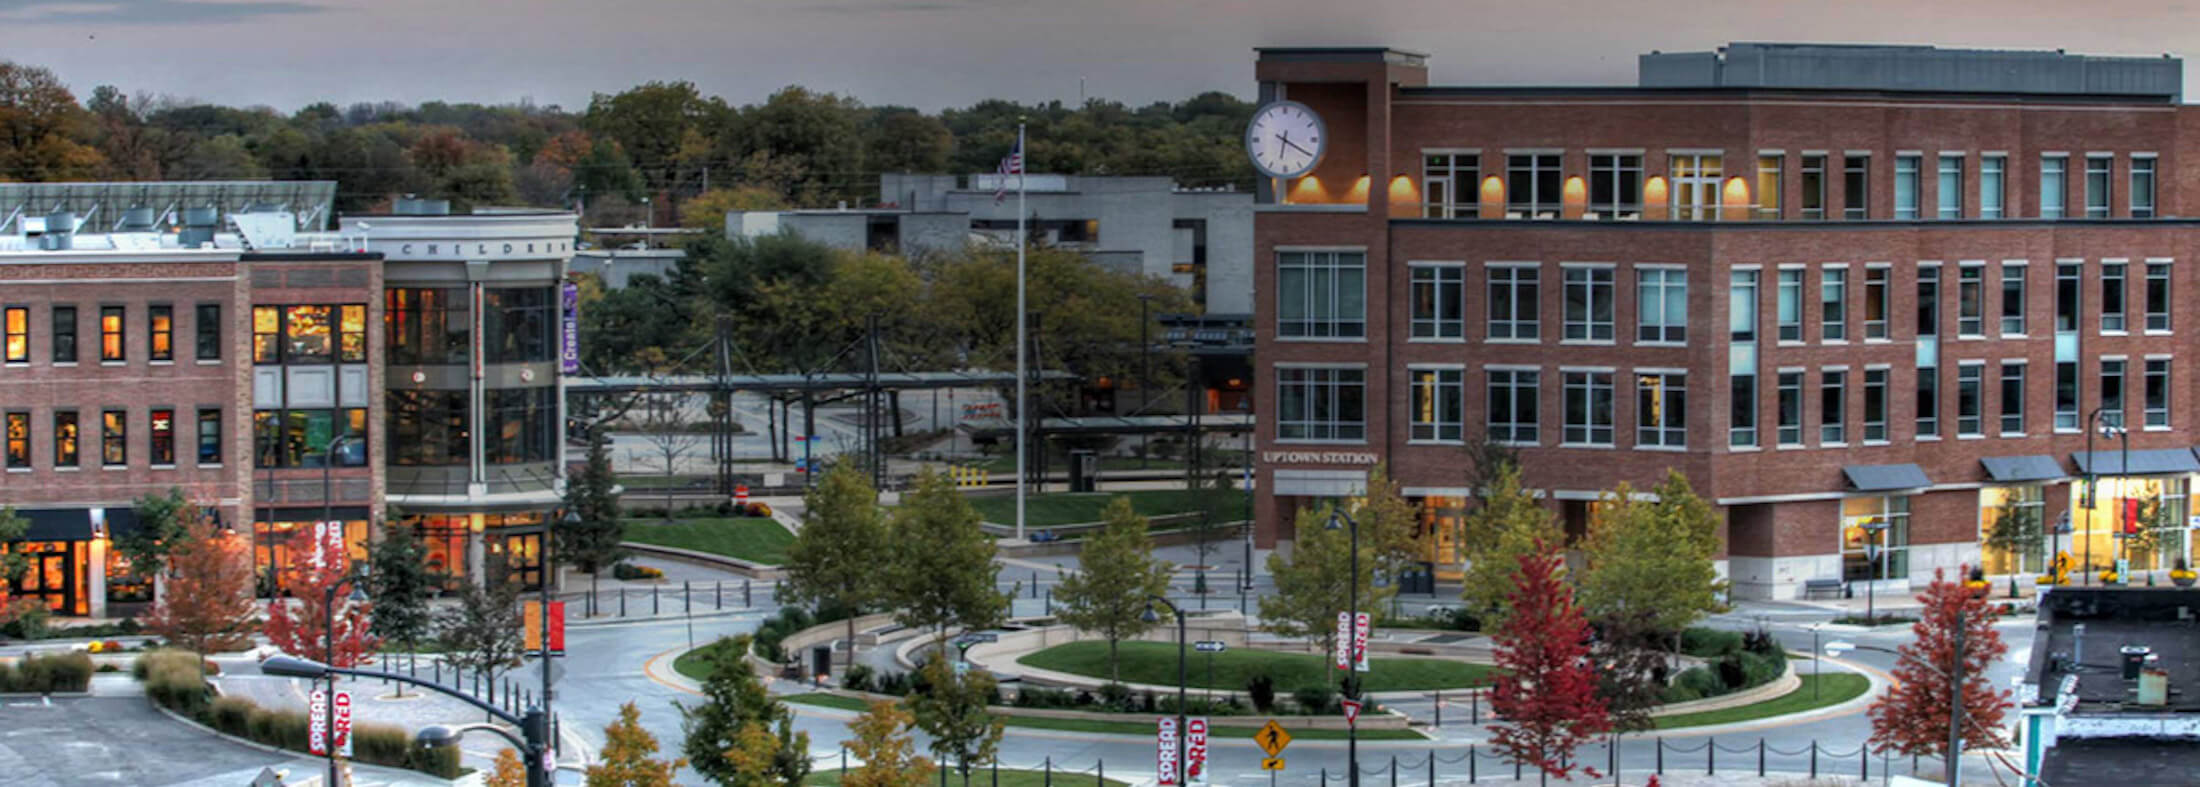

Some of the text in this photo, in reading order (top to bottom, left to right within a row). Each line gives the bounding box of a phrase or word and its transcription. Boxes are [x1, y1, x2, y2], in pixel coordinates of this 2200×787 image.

[1263, 451, 1379, 464] UPTOWN STATION
[1337, 611, 1351, 665] SPREAD
[311, 690, 327, 751] SPREAD
[335, 692, 351, 733] RED
[1159, 718, 1177, 780] SPREAD
[1188, 719, 1206, 761] RED
